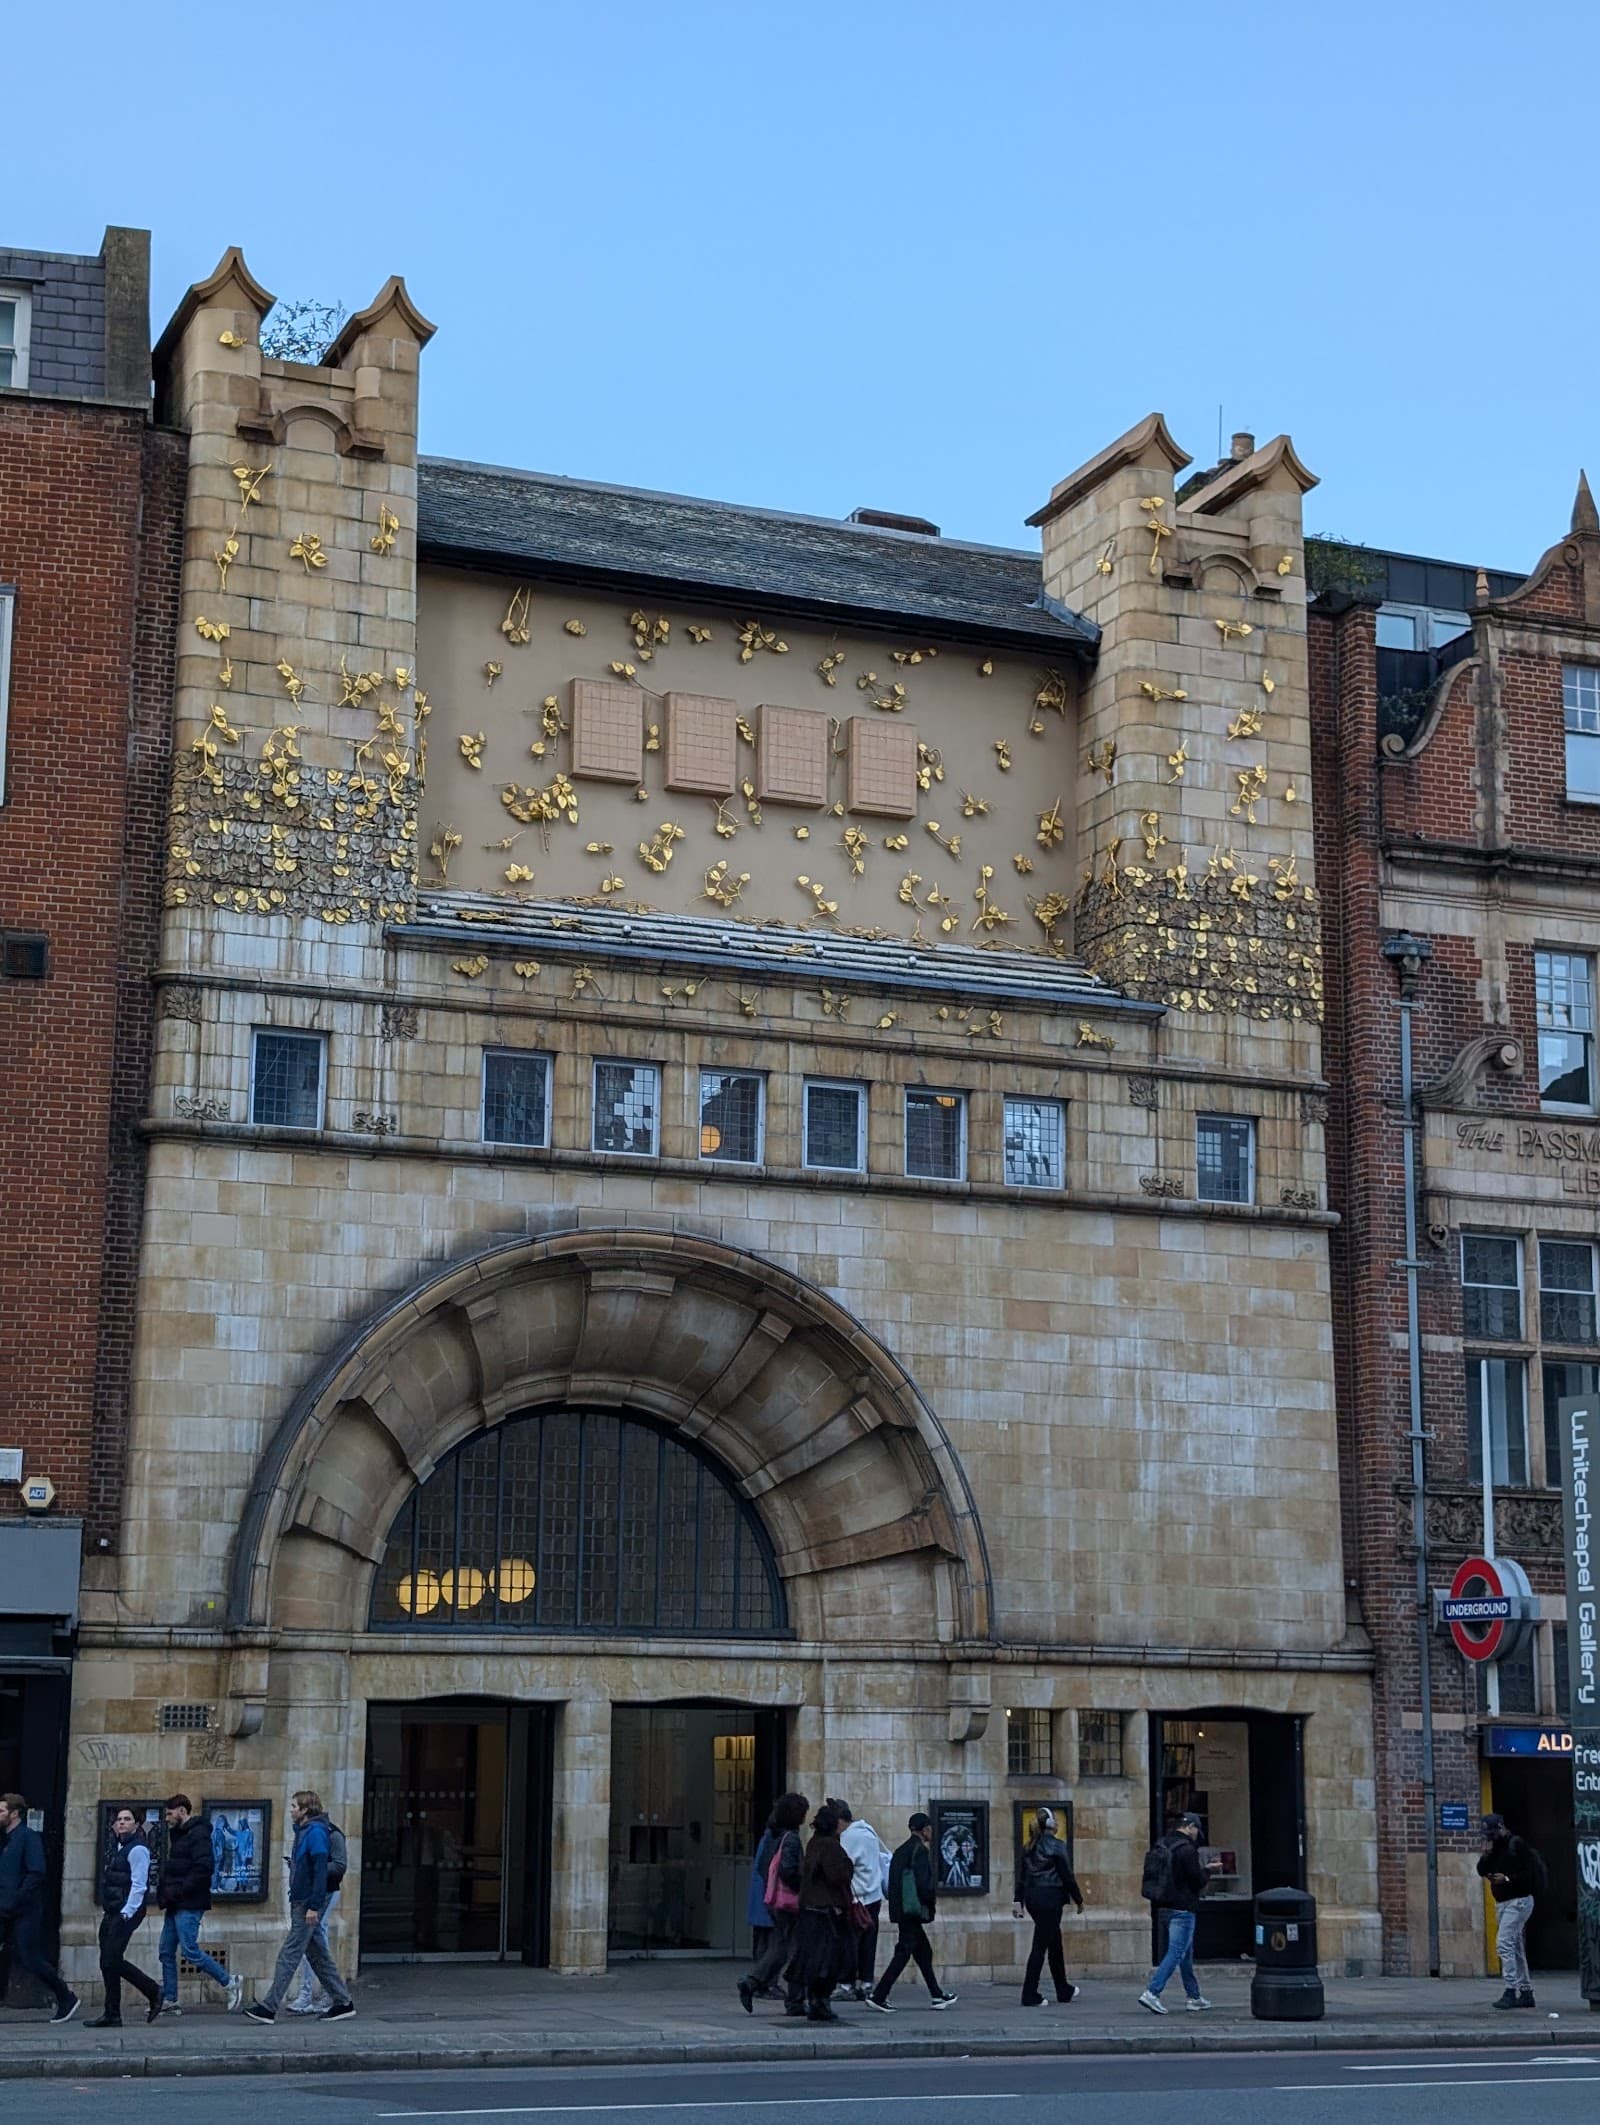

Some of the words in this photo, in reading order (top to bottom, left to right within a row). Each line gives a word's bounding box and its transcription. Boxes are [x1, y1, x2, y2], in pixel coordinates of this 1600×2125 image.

[1456, 1119, 1504, 1152] THE
[1516, 1126, 1600, 1164] PASSM
[1571, 1410, 1596, 1592] Whitechapel
[1446, 1602, 1508, 1617] UNDERGROUND
[1578, 1602, 1597, 1704] Gallery
[1537, 1733, 1573, 1751] ALD
[1575, 1744, 1600, 1765] Fre
